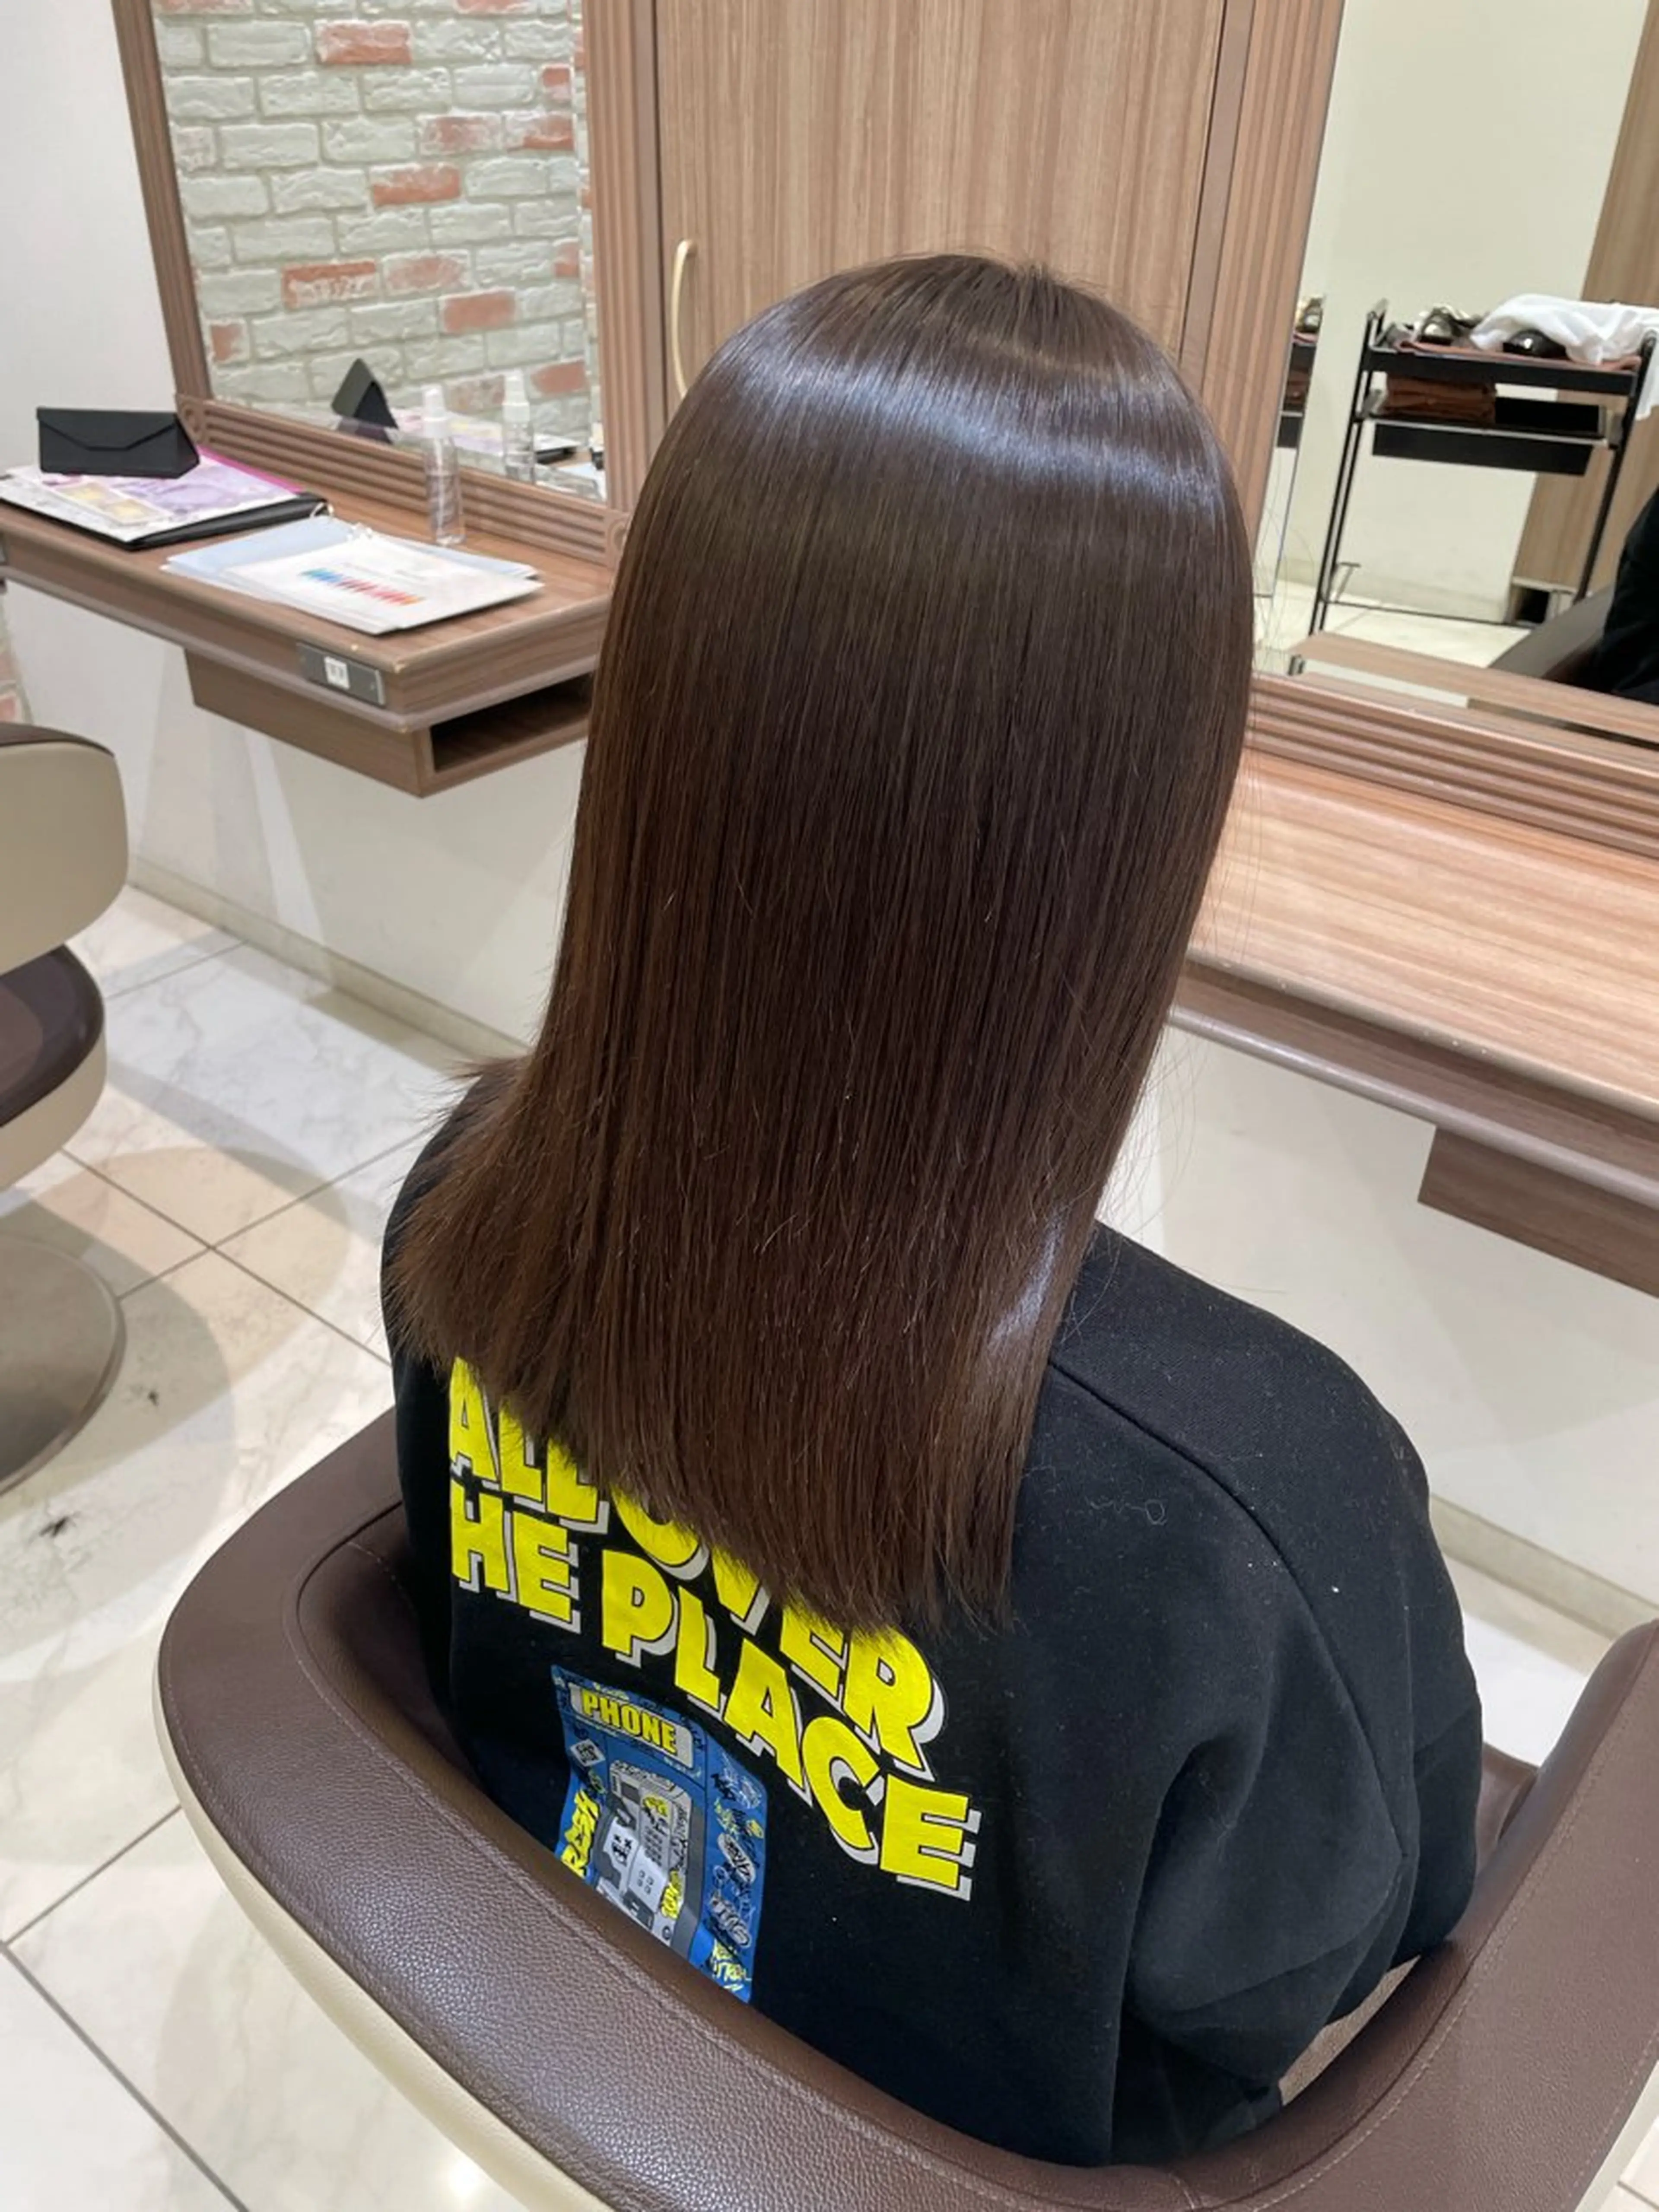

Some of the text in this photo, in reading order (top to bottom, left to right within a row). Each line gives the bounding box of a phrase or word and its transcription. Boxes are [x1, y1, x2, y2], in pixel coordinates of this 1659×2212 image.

[449, 1356, 609, 1535] ALL
[582, 1687, 677, 1754] PHONE
[602, 1549, 982, 1900] PLACE
